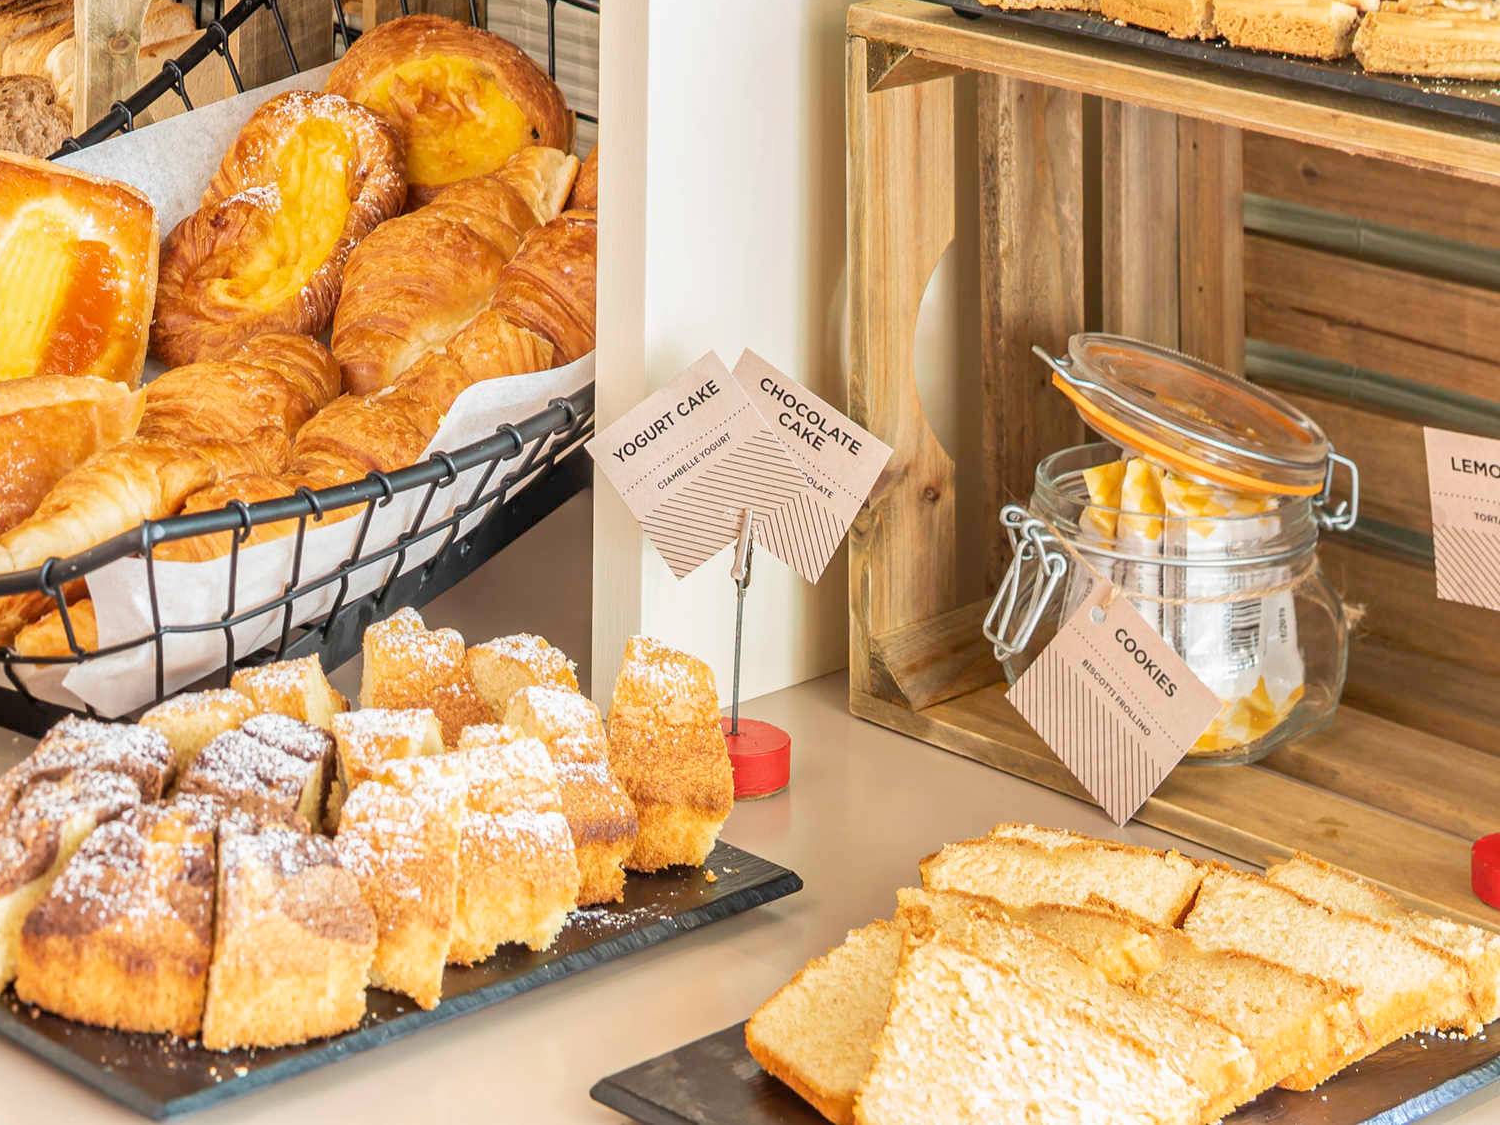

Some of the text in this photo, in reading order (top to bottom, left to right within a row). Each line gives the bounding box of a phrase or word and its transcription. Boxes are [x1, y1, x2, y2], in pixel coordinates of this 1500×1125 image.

[612, 379, 721, 464] YOGURT CAKE
[759, 377, 863, 457] CHOCOLATE
[778, 412, 826, 452] CAKE
[656, 432, 732, 491] CIAMBELLE YOGURT
[1451, 456, 1500, 480] LEMO
[1081, 659, 1151, 737] BISCOTTI FROLLINO
[1114, 628, 1178, 699] COOKIES
